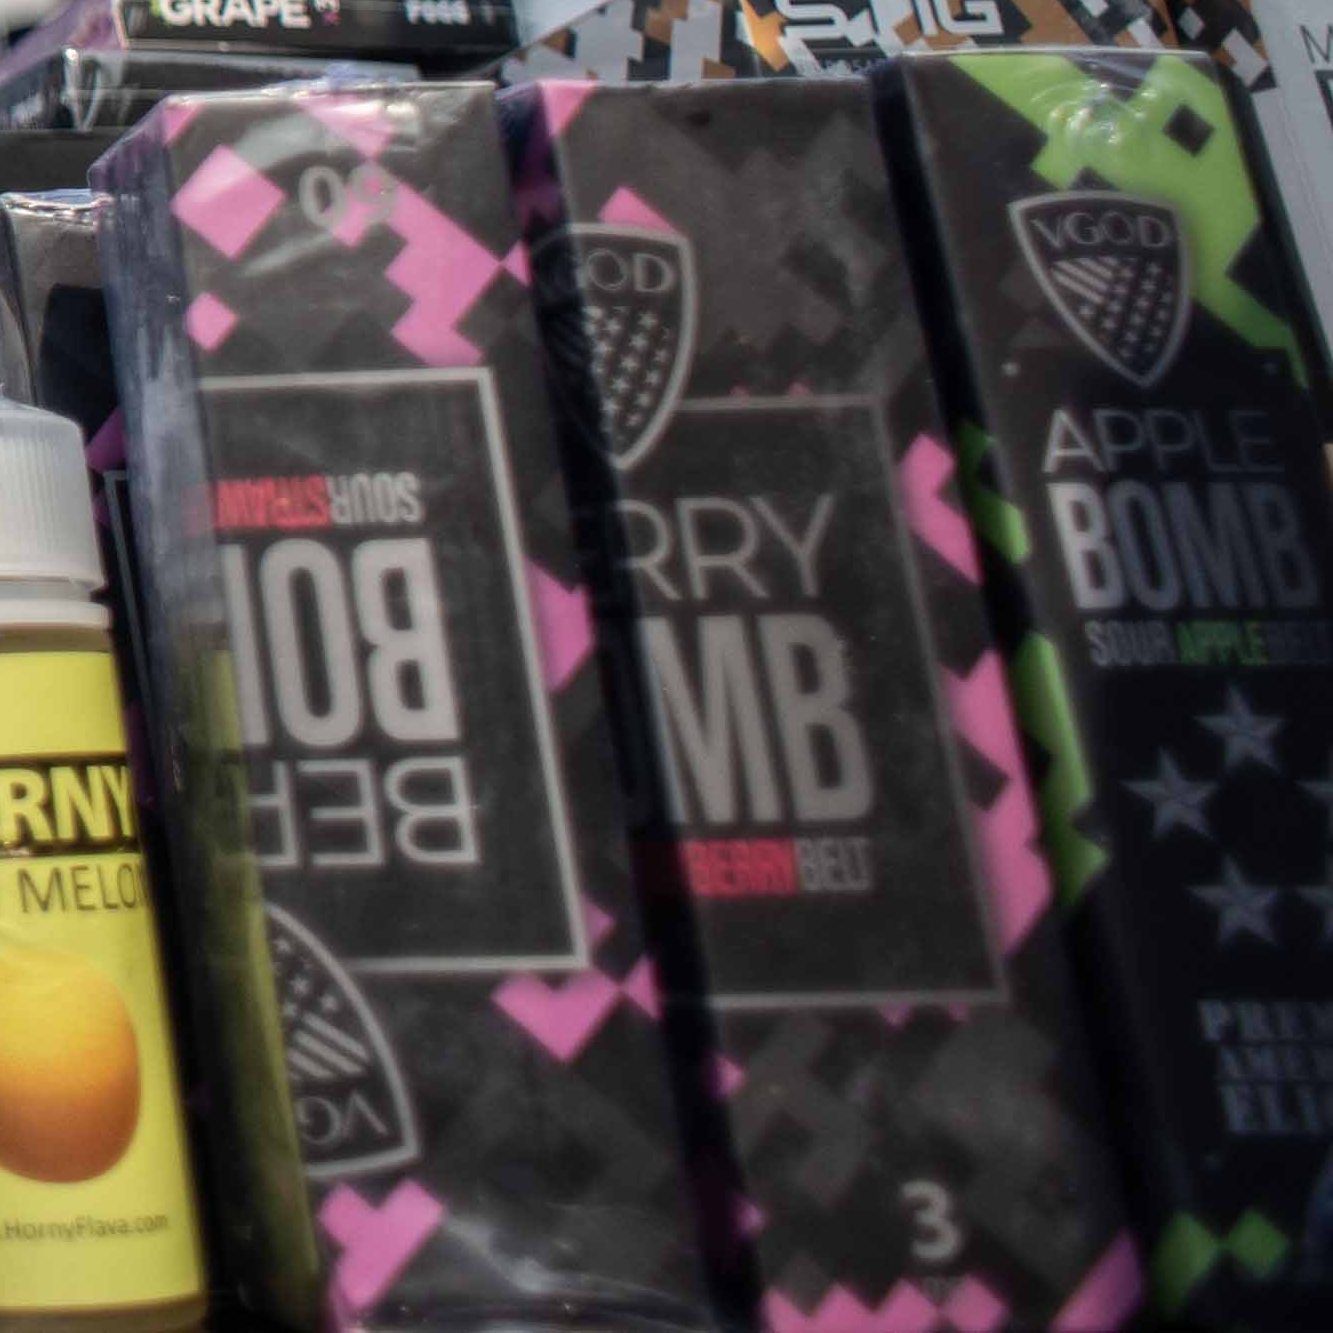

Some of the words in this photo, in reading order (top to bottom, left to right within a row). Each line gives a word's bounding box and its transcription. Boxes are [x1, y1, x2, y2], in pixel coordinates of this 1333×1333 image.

[1033, 211, 1175, 250] VGOD
[1043, 408, 1285, 473] APPLE
[616, 494, 833, 602] RRY
[1047, 481, 1319, 611] BOMB
[902, 1180, 962, 1261] 3
